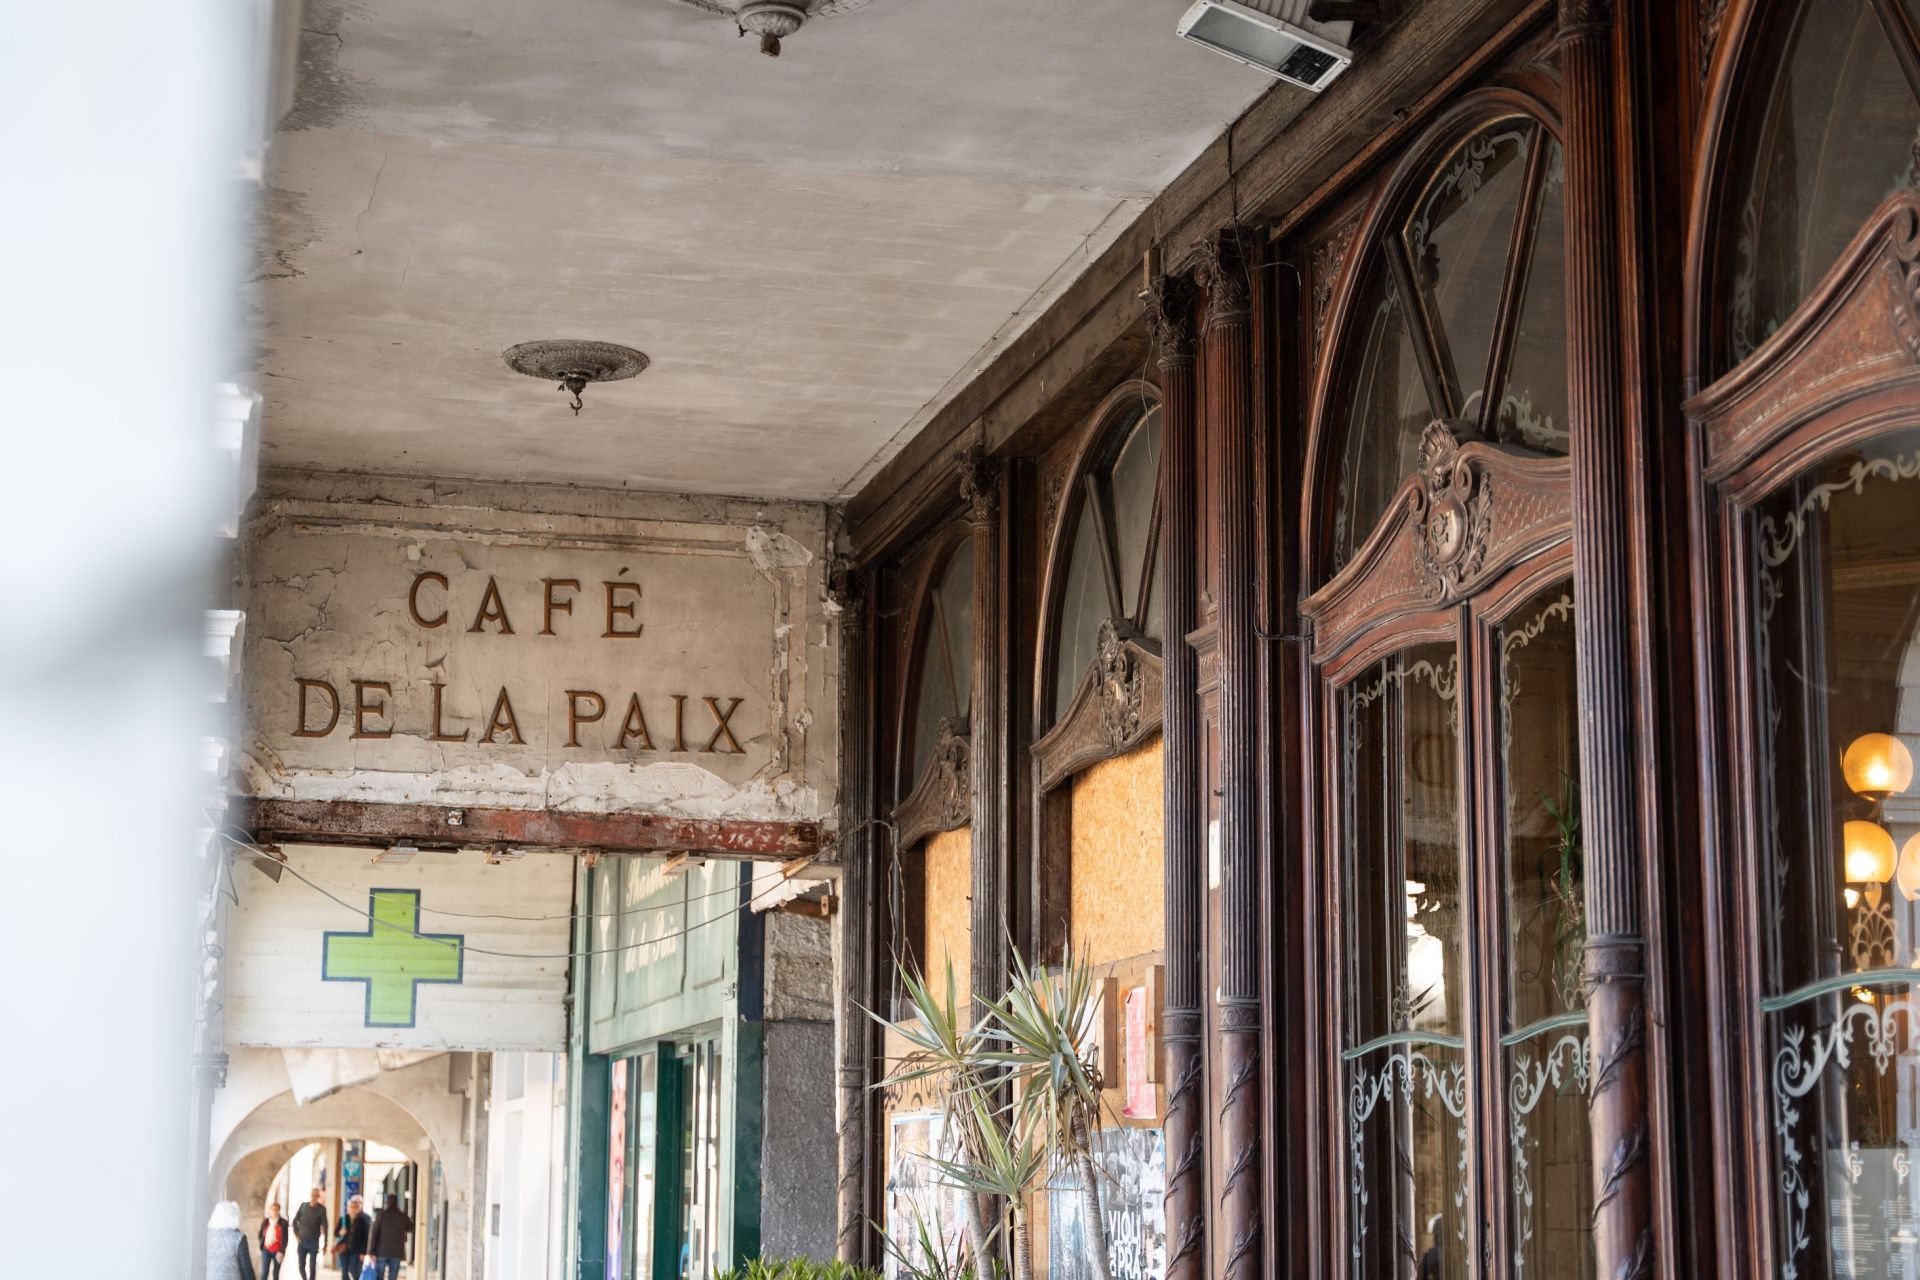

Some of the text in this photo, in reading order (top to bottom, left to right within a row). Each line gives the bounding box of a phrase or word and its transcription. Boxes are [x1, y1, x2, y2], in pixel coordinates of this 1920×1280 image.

[408, 567, 643, 639] CAFÉ
[291, 677, 747, 754] DE LA PAIX
